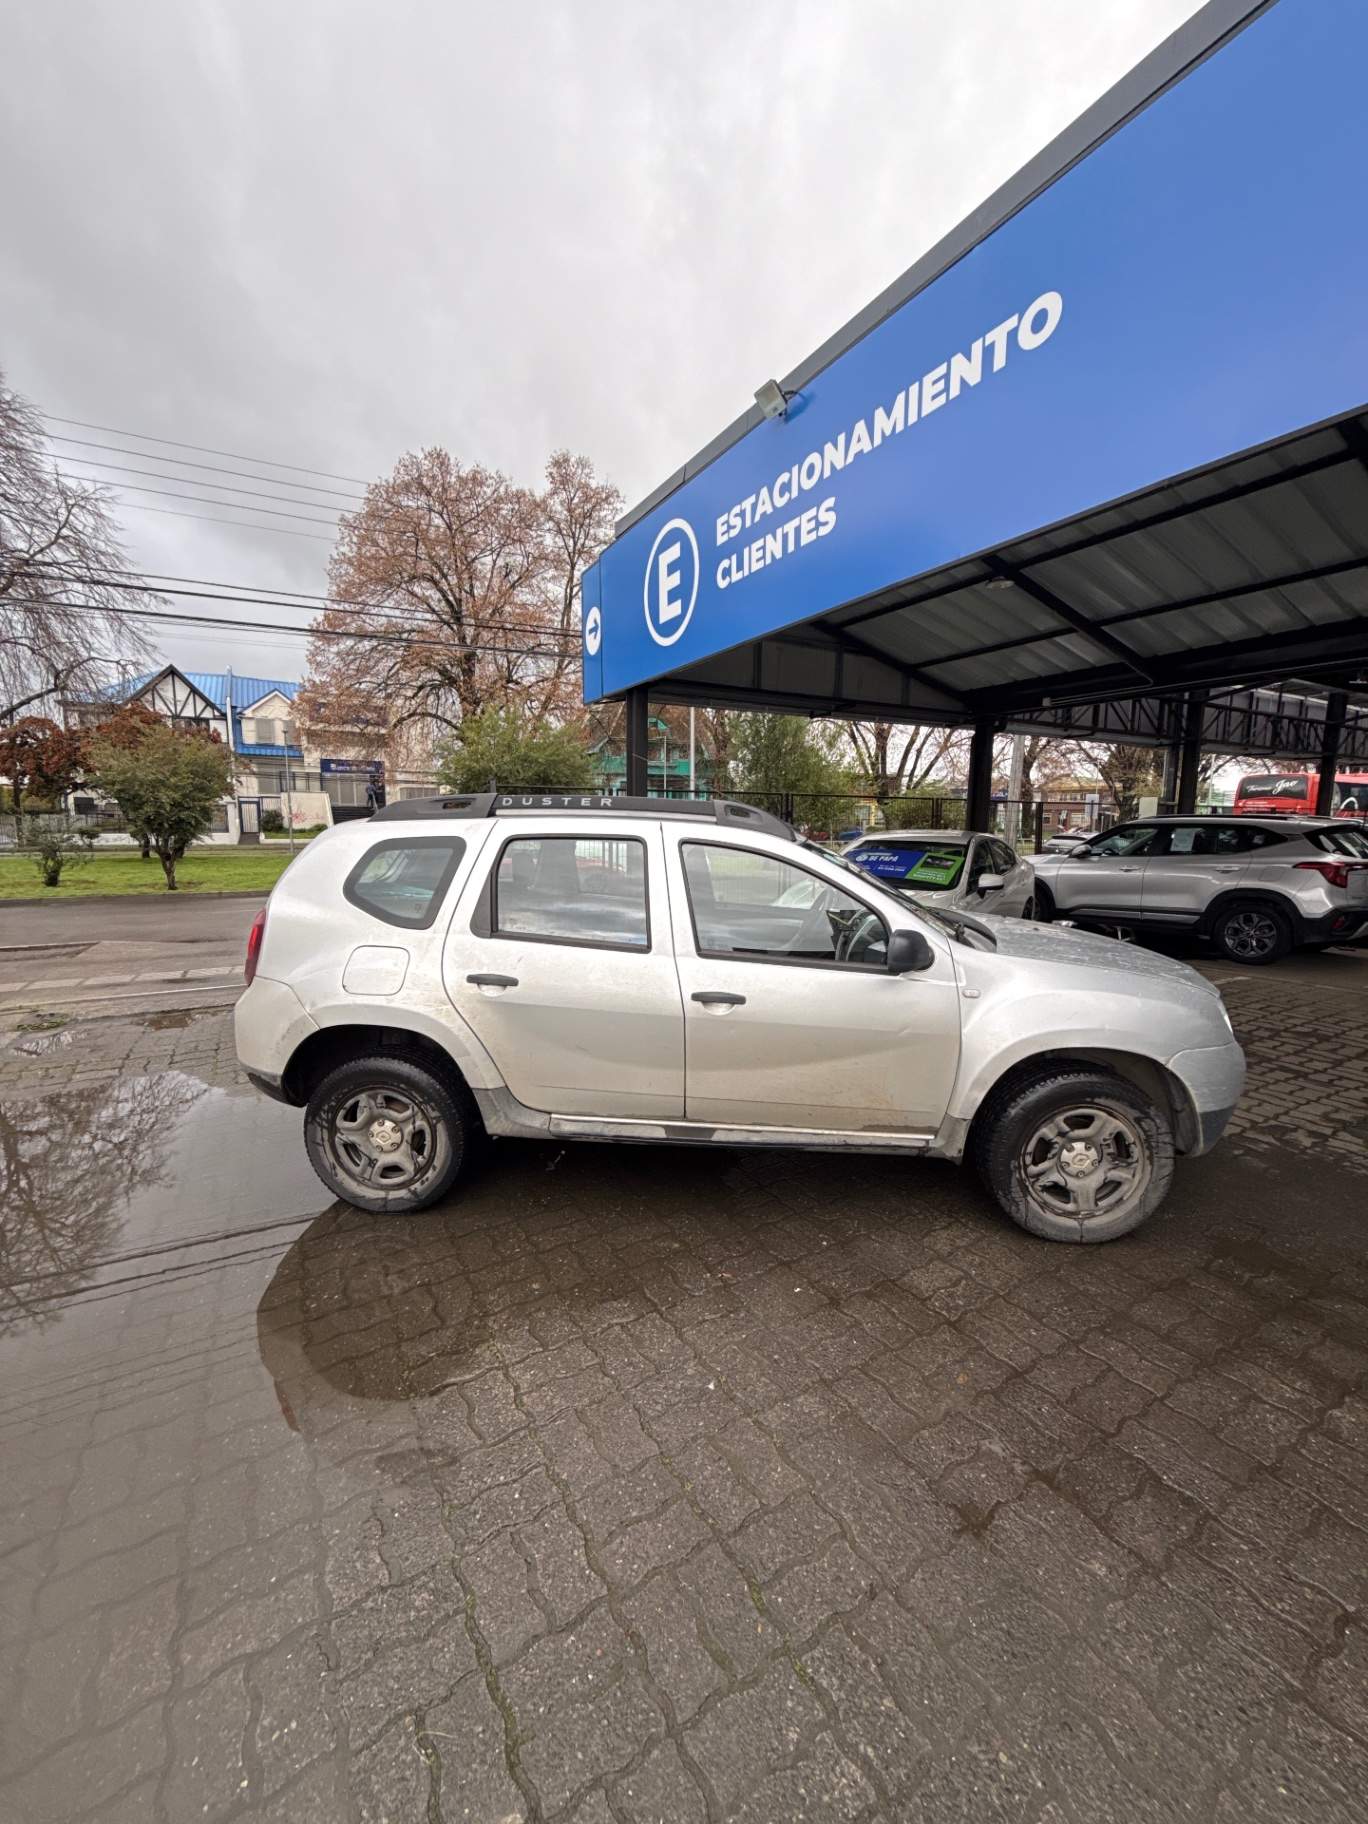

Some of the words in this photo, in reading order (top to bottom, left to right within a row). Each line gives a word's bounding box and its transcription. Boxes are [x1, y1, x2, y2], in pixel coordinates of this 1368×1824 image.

[715, 291, 1063, 546] ESTACIONAMIENTO
[658, 542, 682, 624] E
[716, 496, 837, 589] CLIENTES
[502, 797, 613, 807] DUSTER
